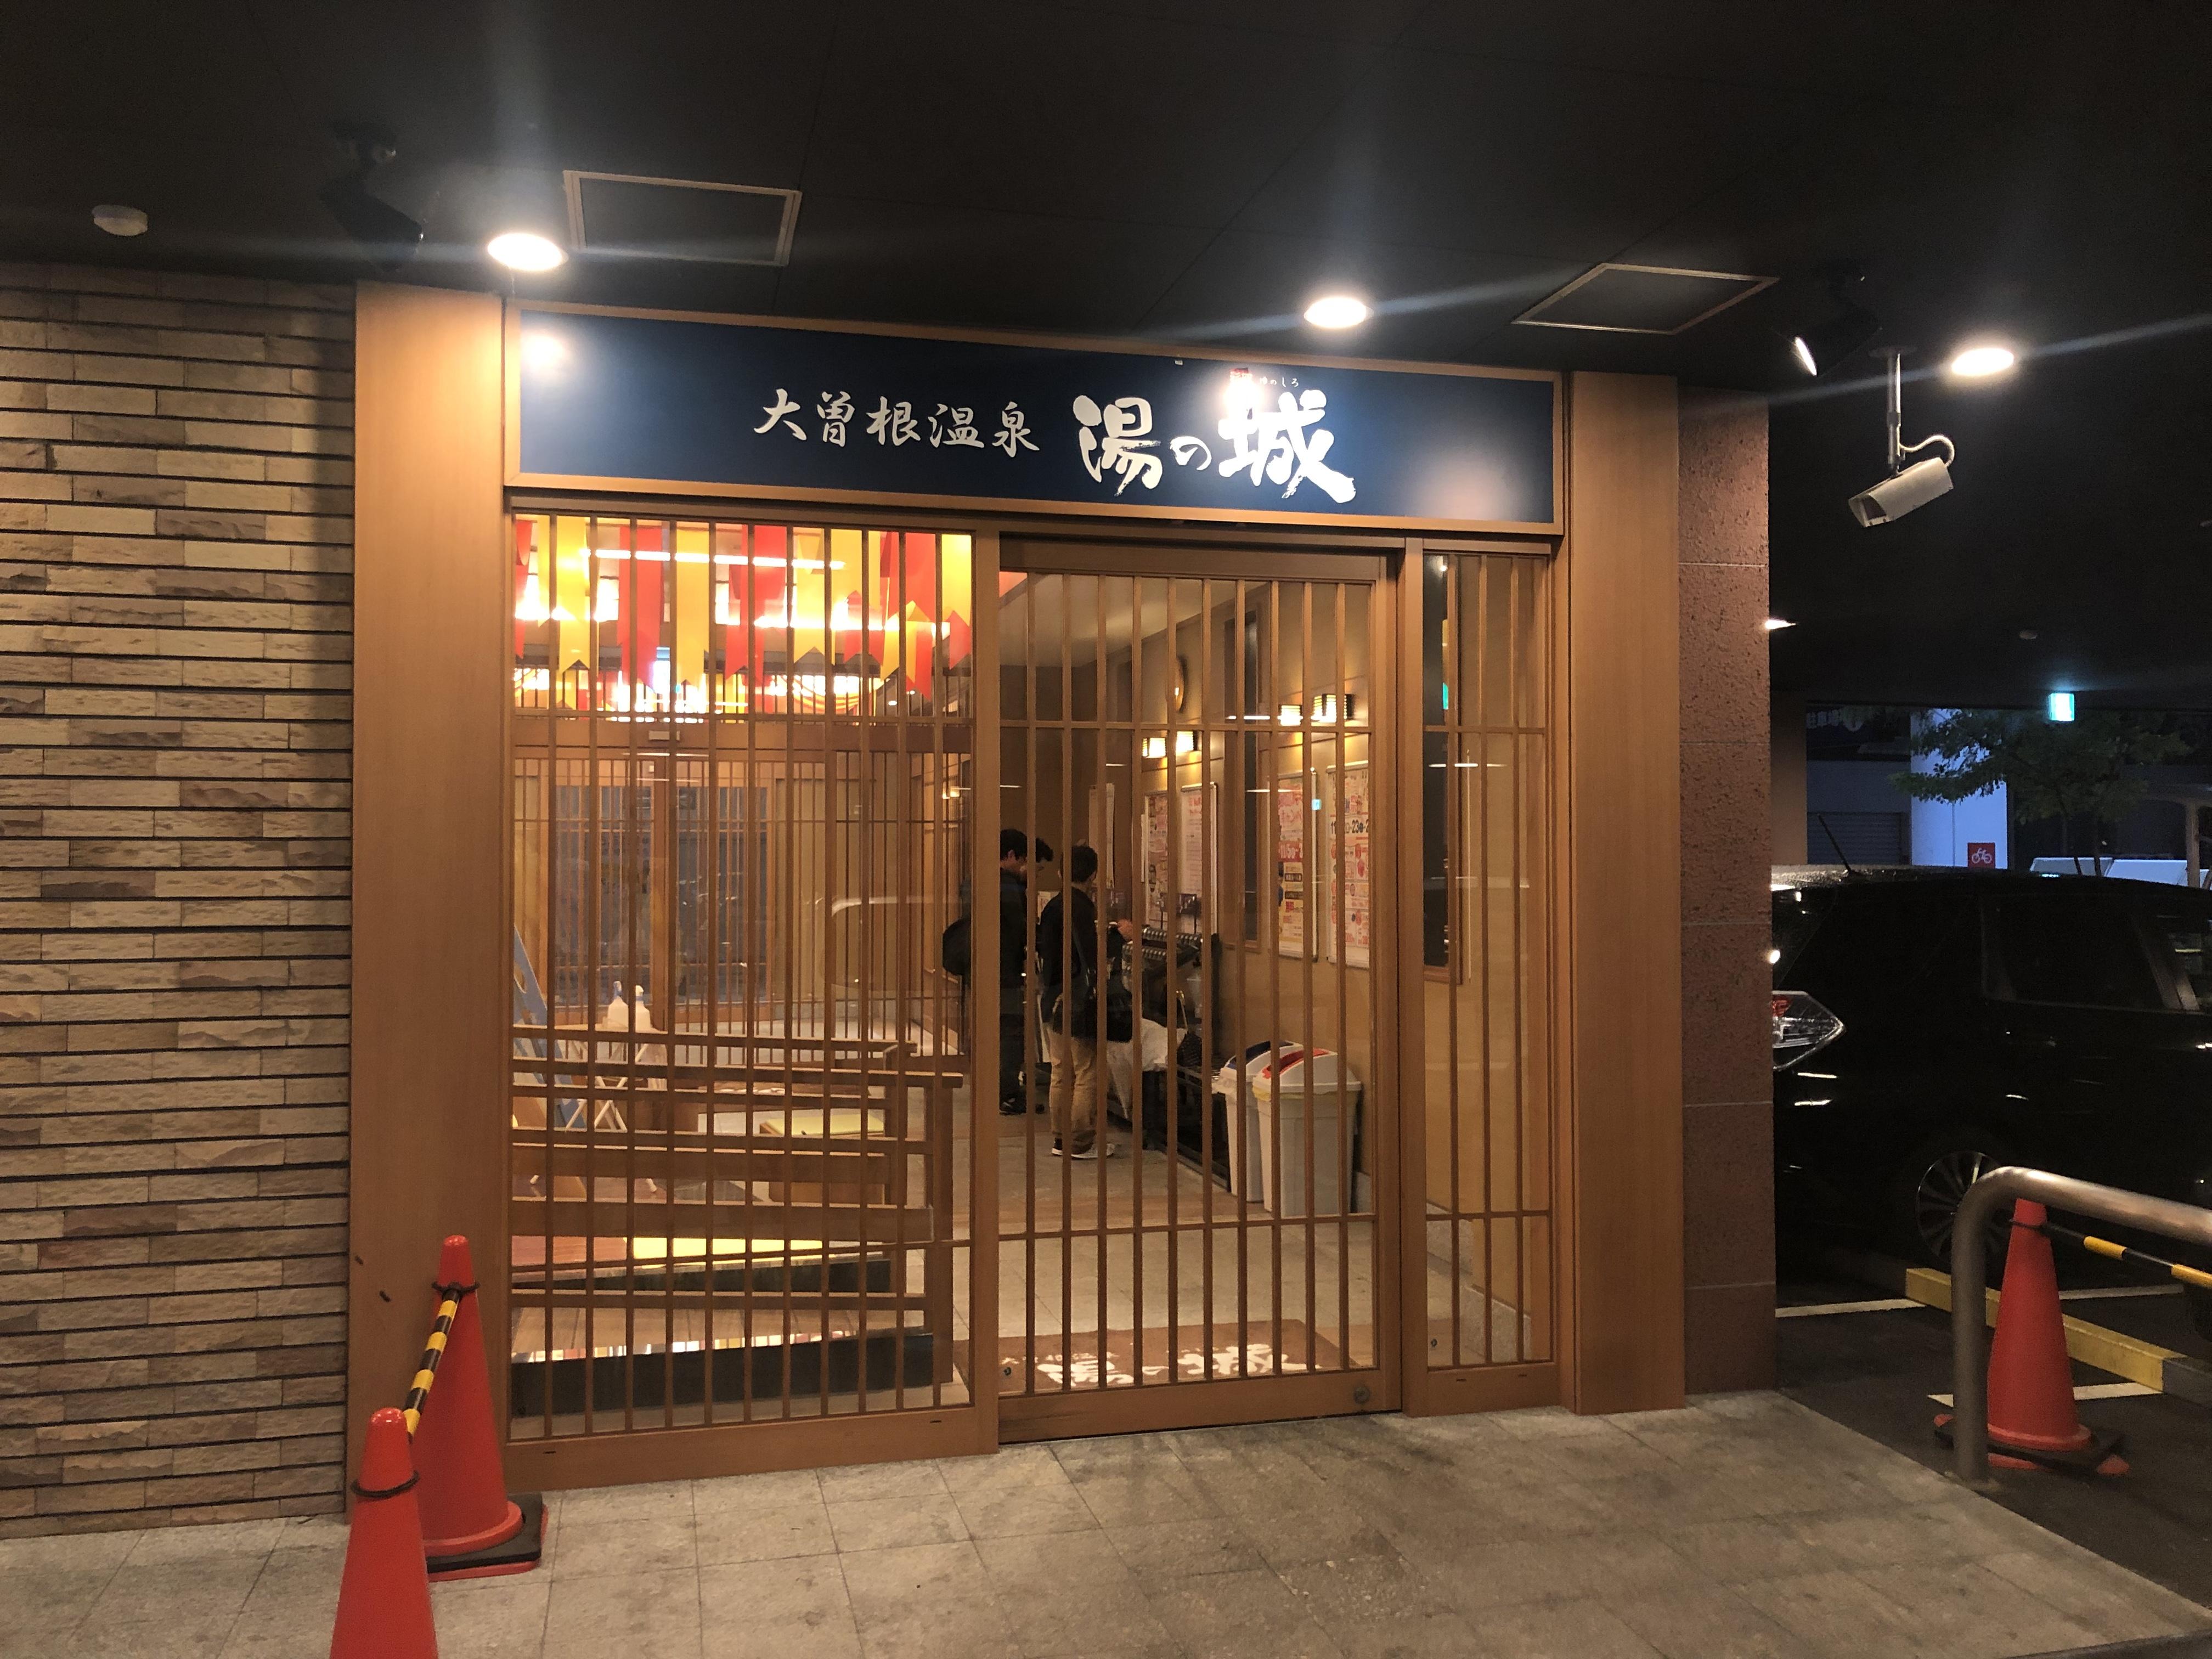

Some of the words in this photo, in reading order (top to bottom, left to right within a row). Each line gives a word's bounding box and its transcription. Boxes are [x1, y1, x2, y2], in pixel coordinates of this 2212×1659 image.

[753, 388, 1040, 458] 大曽根温泉
[1073, 389, 1357, 504] 湯の城
